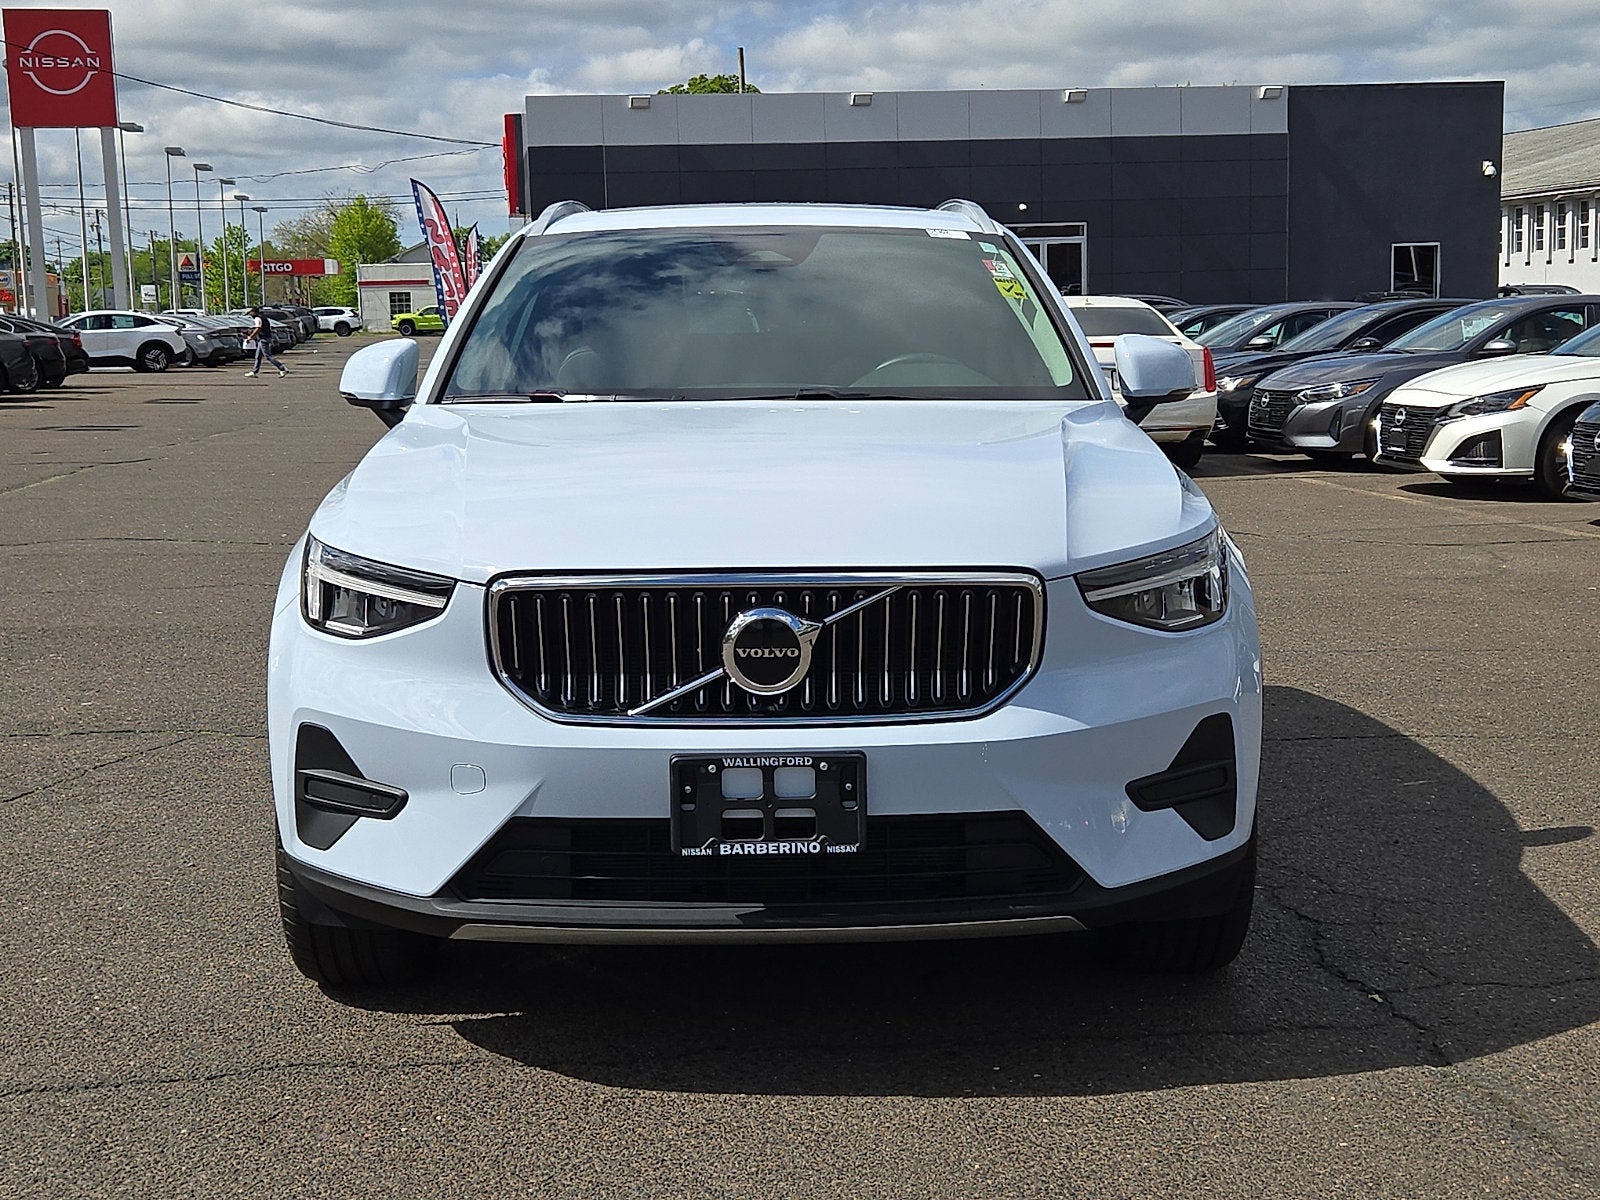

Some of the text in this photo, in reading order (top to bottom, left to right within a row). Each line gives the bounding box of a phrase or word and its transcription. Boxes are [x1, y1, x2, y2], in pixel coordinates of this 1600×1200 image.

[19, 57, 100, 68] NISSAN
[736, 648, 799, 657] VOLVO
[722, 757, 813, 767] WALLINGFORD
[682, 842, 857, 856] NISSAN BARBERINO NISSAN
